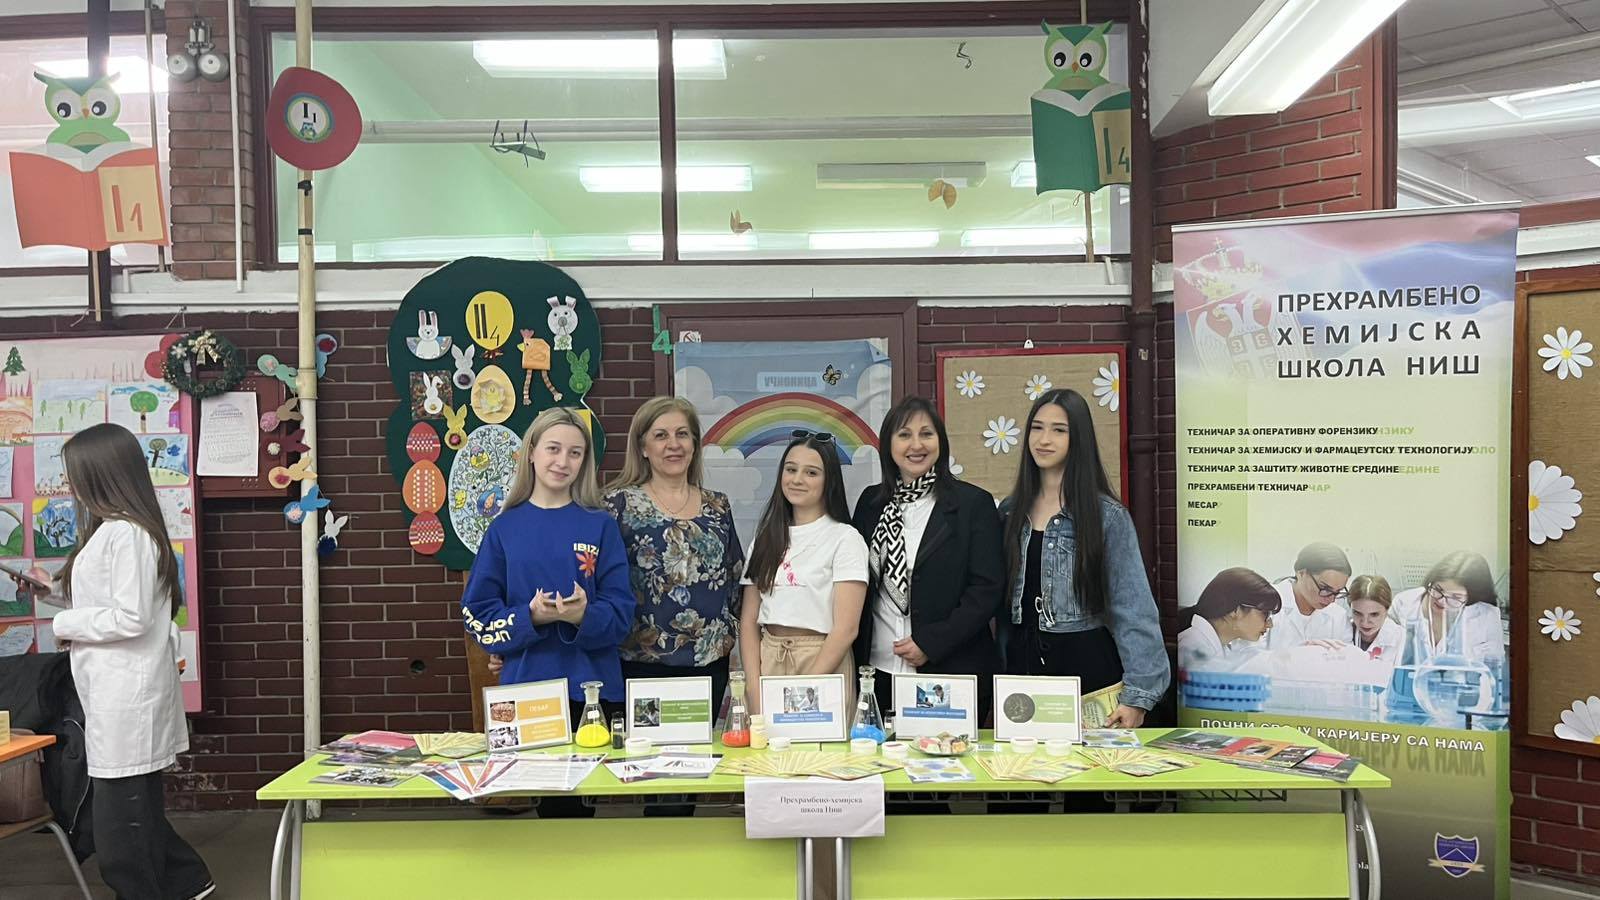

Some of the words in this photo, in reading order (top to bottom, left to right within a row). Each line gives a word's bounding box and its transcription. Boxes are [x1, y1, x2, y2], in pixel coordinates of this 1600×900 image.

[1278, 285, 1480, 312] ПРЕХРАМБЕНО
[1277, 320, 1481, 346] ХЕМИЈСКА
[1278, 358, 1386, 378] ШКОЛА
[1407, 355, 1480, 375] НИШ
[1187, 428, 1236, 436] ТЕХНИЧАР
[1238, 428, 1250, 436] ЗА
[1252, 427, 1316, 436] ОПЕРАТИВНУ
[1318, 427, 1379, 435] ФОРЕНЗИКУ
[1187, 446, 1236, 454] ТЕХНИЧАР
[1238, 446, 1250, 454] ЗА
[1252, 446, 1303, 454] ХЕМИЈСКУ
[1305, 446, 1312, 454] И
[1315, 446, 1395, 455] ФАРМАЦЕУТСКУ
[1398, 446, 1473, 454] ТЕХНОЛОГИЈУ
[1187, 465, 1236, 473] ТЕХНИЧАР
[1238, 465, 1250, 473] ЗА
[1252, 465, 1298, 473] ЗАШТИТУ
[1300, 465, 1349, 473] ЖИВОТНЕ
[1352, 465, 1400, 474] СРЕДИНЕ
[1187, 483, 1256, 491] ПРЕХРАМБЕНИ
[1257, 483, 1309, 491] ТЕХНИЧАР
[1187, 501, 1219, 509] МЕСАР
[1187, 519, 1217, 527] ПЕКАР
[1317, 729, 1401, 744] КАРИЈЕРУ
[1407, 735, 1429, 747] СА
[1435, 738, 1485, 752] НАМА
